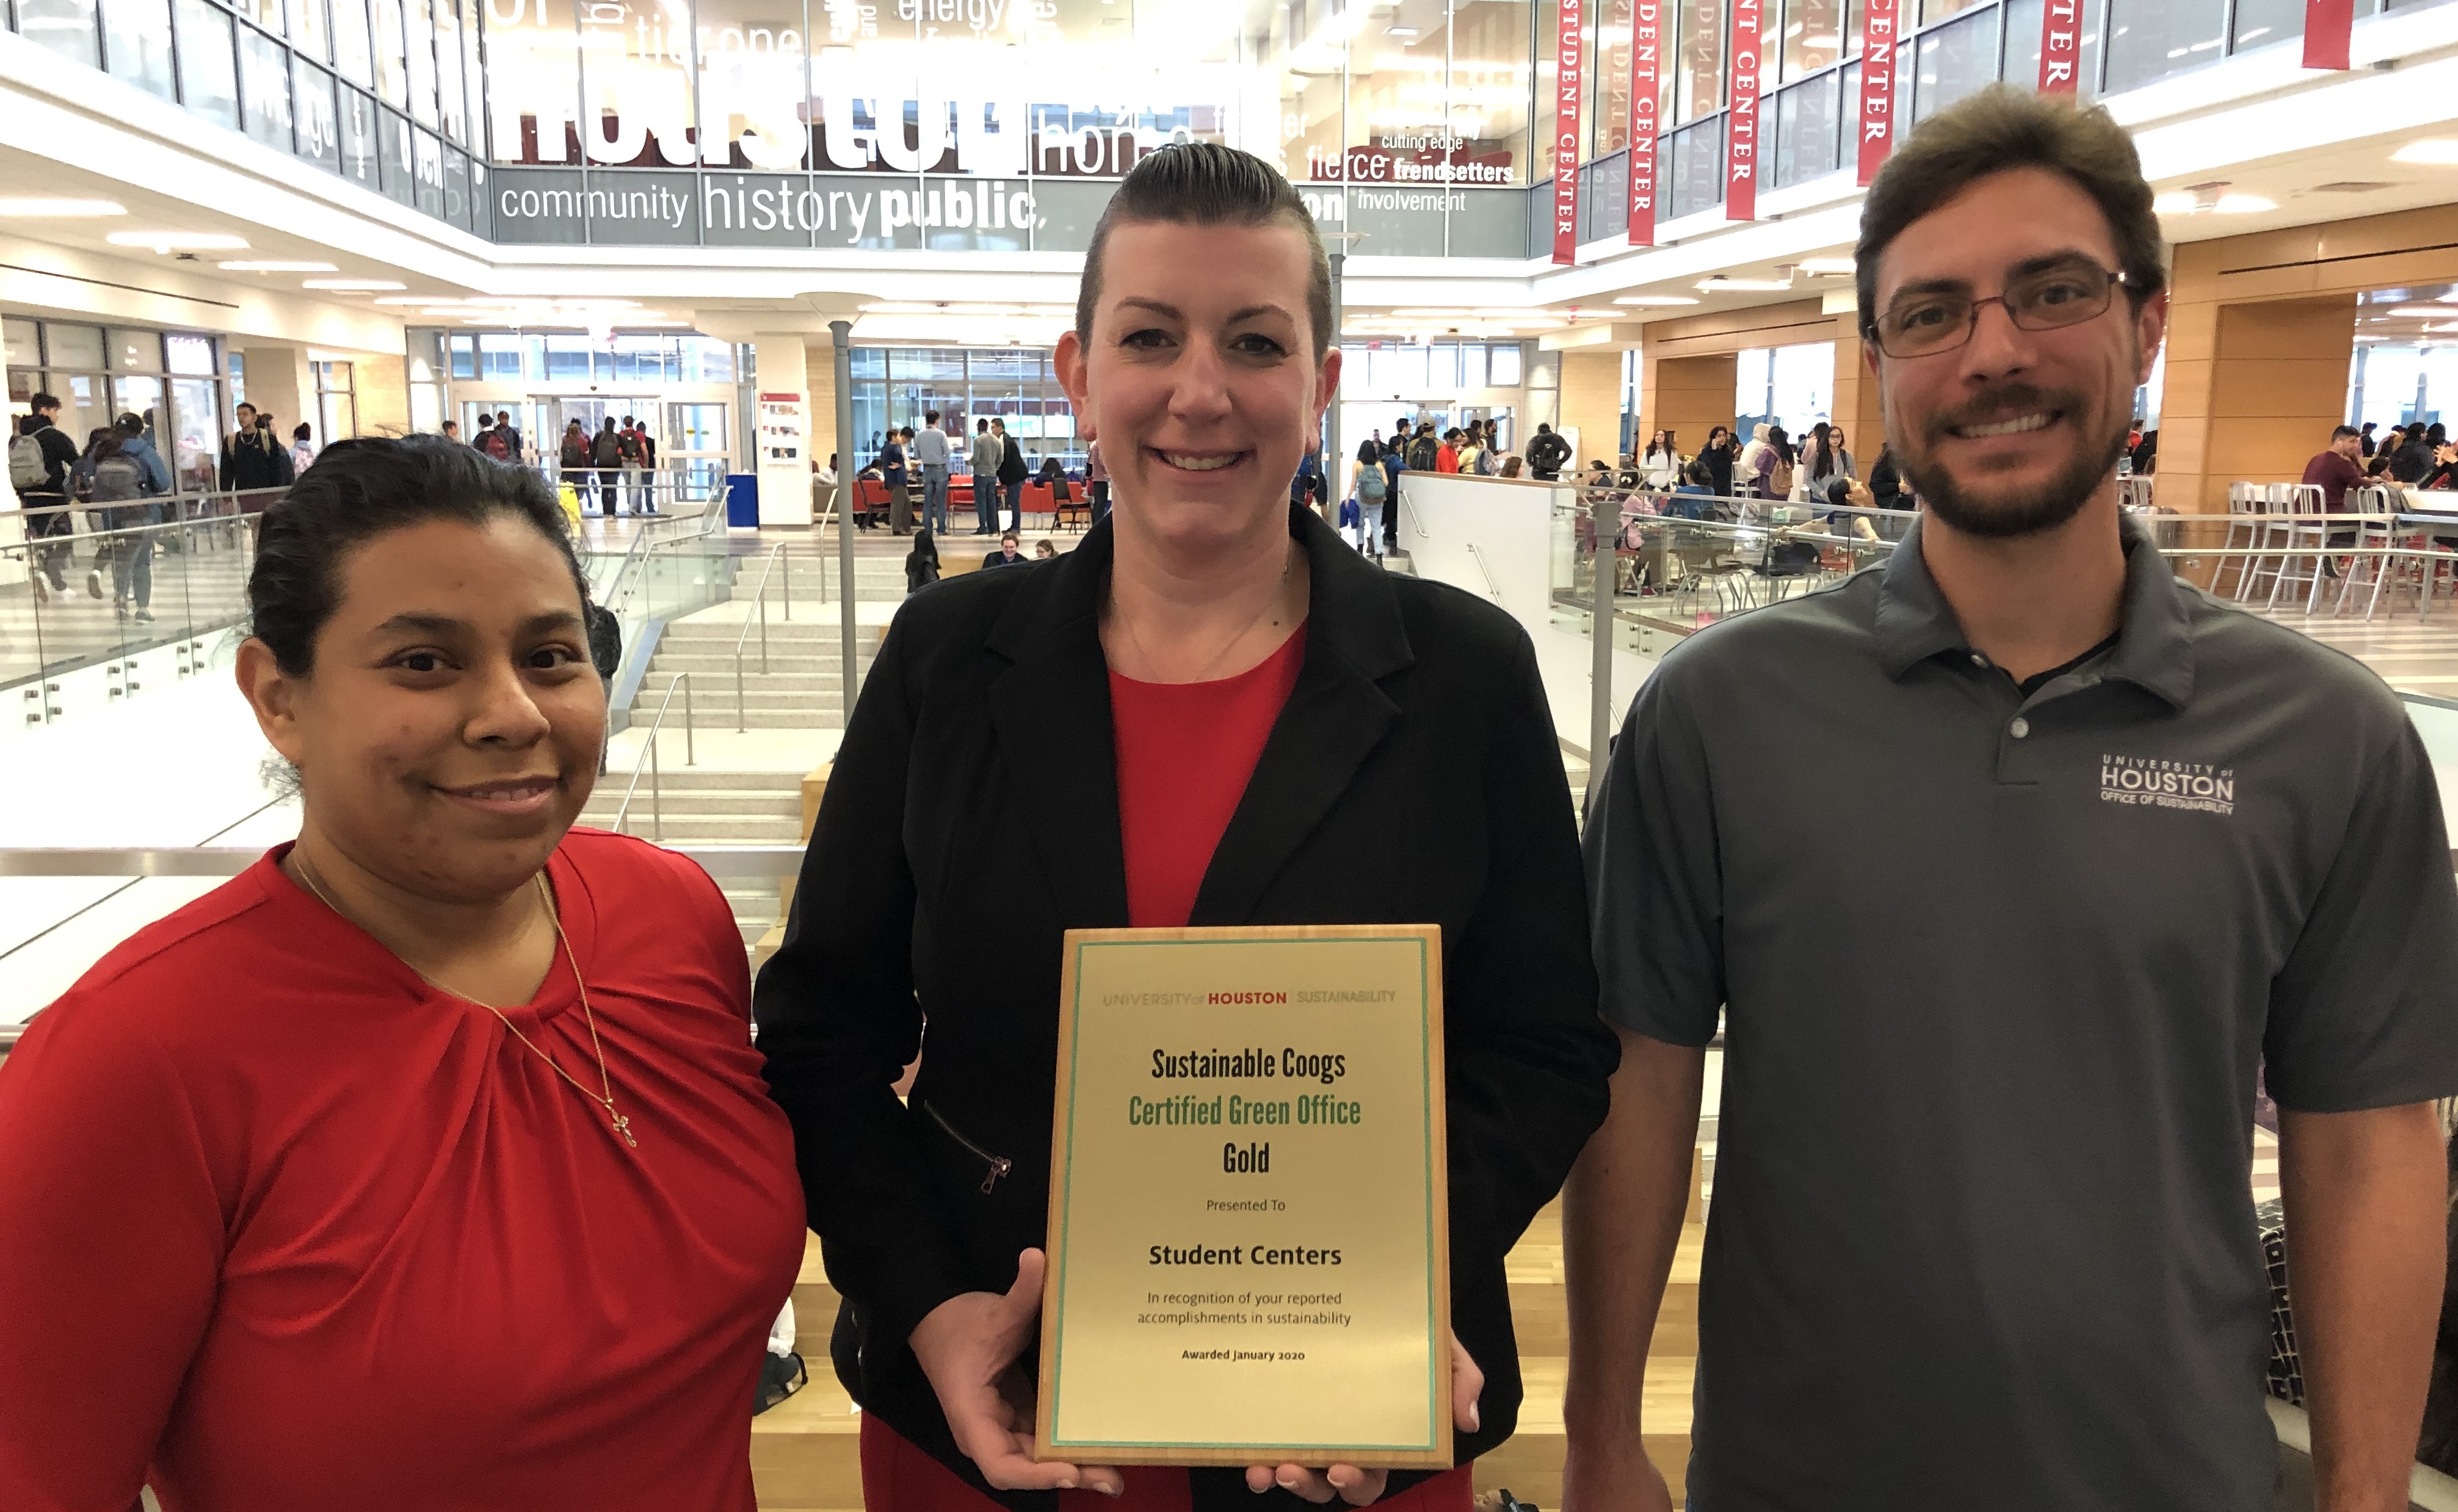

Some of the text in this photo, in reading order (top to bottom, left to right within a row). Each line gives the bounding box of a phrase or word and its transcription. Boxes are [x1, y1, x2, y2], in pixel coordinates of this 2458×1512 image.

[899, 0, 1005, 31] energy
[1558, 0, 1579, 236] STUDENT CENTER
[1733, 51, 1756, 183] CENTER
[1382, 134, 1463, 153] cutting edge
[1634, 97, 1654, 212] CENTER
[1306, 145, 1386, 179] fierce
[1393, 157, 1514, 183] trendsetters
[501, 184, 689, 228] community
[705, 176, 872, 244] history
[1358, 189, 1466, 212] involvement
[2103, 753, 2214, 775] UNIVERSITY
[2101, 765, 2234, 801] HOUSTON
[2100, 790, 2234, 815] OFFICE OF SUSTAINABILITY
[1102, 989, 1397, 1007] UNIVERSITY of HOUSTON SUSTAINABILITY
[1151, 1047, 1346, 1085] Sustainable Coogs
[1129, 1094, 1361, 1126] Certified Green Office
[1224, 1142, 1269, 1173] Gold
[1206, 1198, 1286, 1212] Presented To
[1149, 1244, 1342, 1266] Student Centers
[1148, 1292, 1342, 1308] In recognition of your reported
[1137, 1311, 1351, 1328] accomplishments in sustainability
[1181, 1348, 1306, 1363] Awarded January 2020
